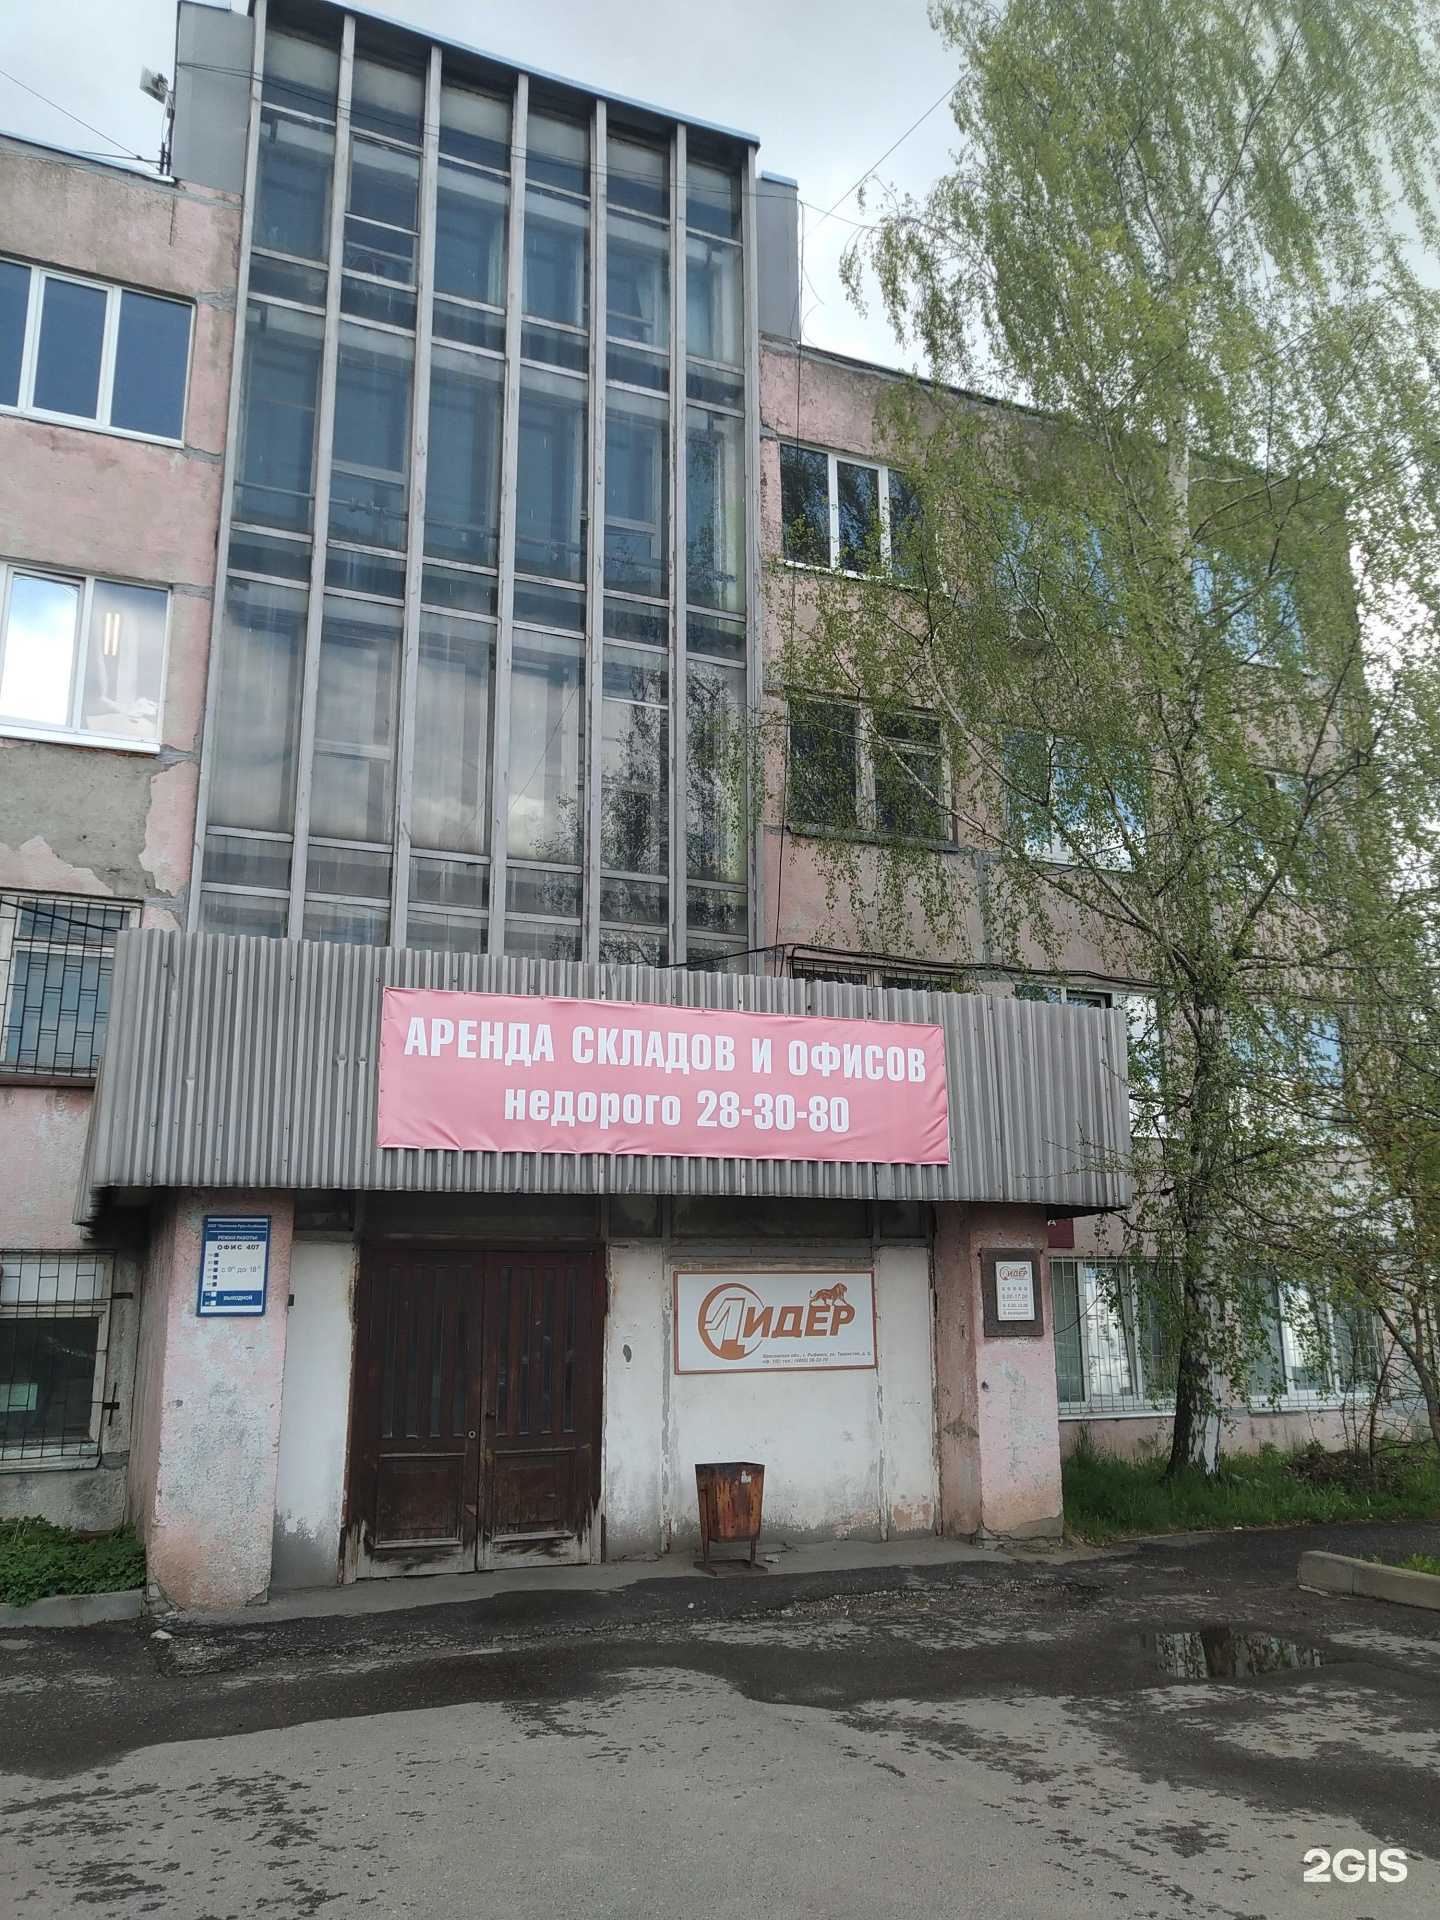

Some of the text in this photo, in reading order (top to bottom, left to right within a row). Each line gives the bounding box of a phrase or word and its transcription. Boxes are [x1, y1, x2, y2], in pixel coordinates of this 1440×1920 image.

[403, 1015, 927, 1083] АРЕНДА СКЛАДОВ И ОФИСОВ
[504, 1088, 851, 1134] недорого 28-30-80
[704, 1297, 856, 1357] ЛИДЕР
